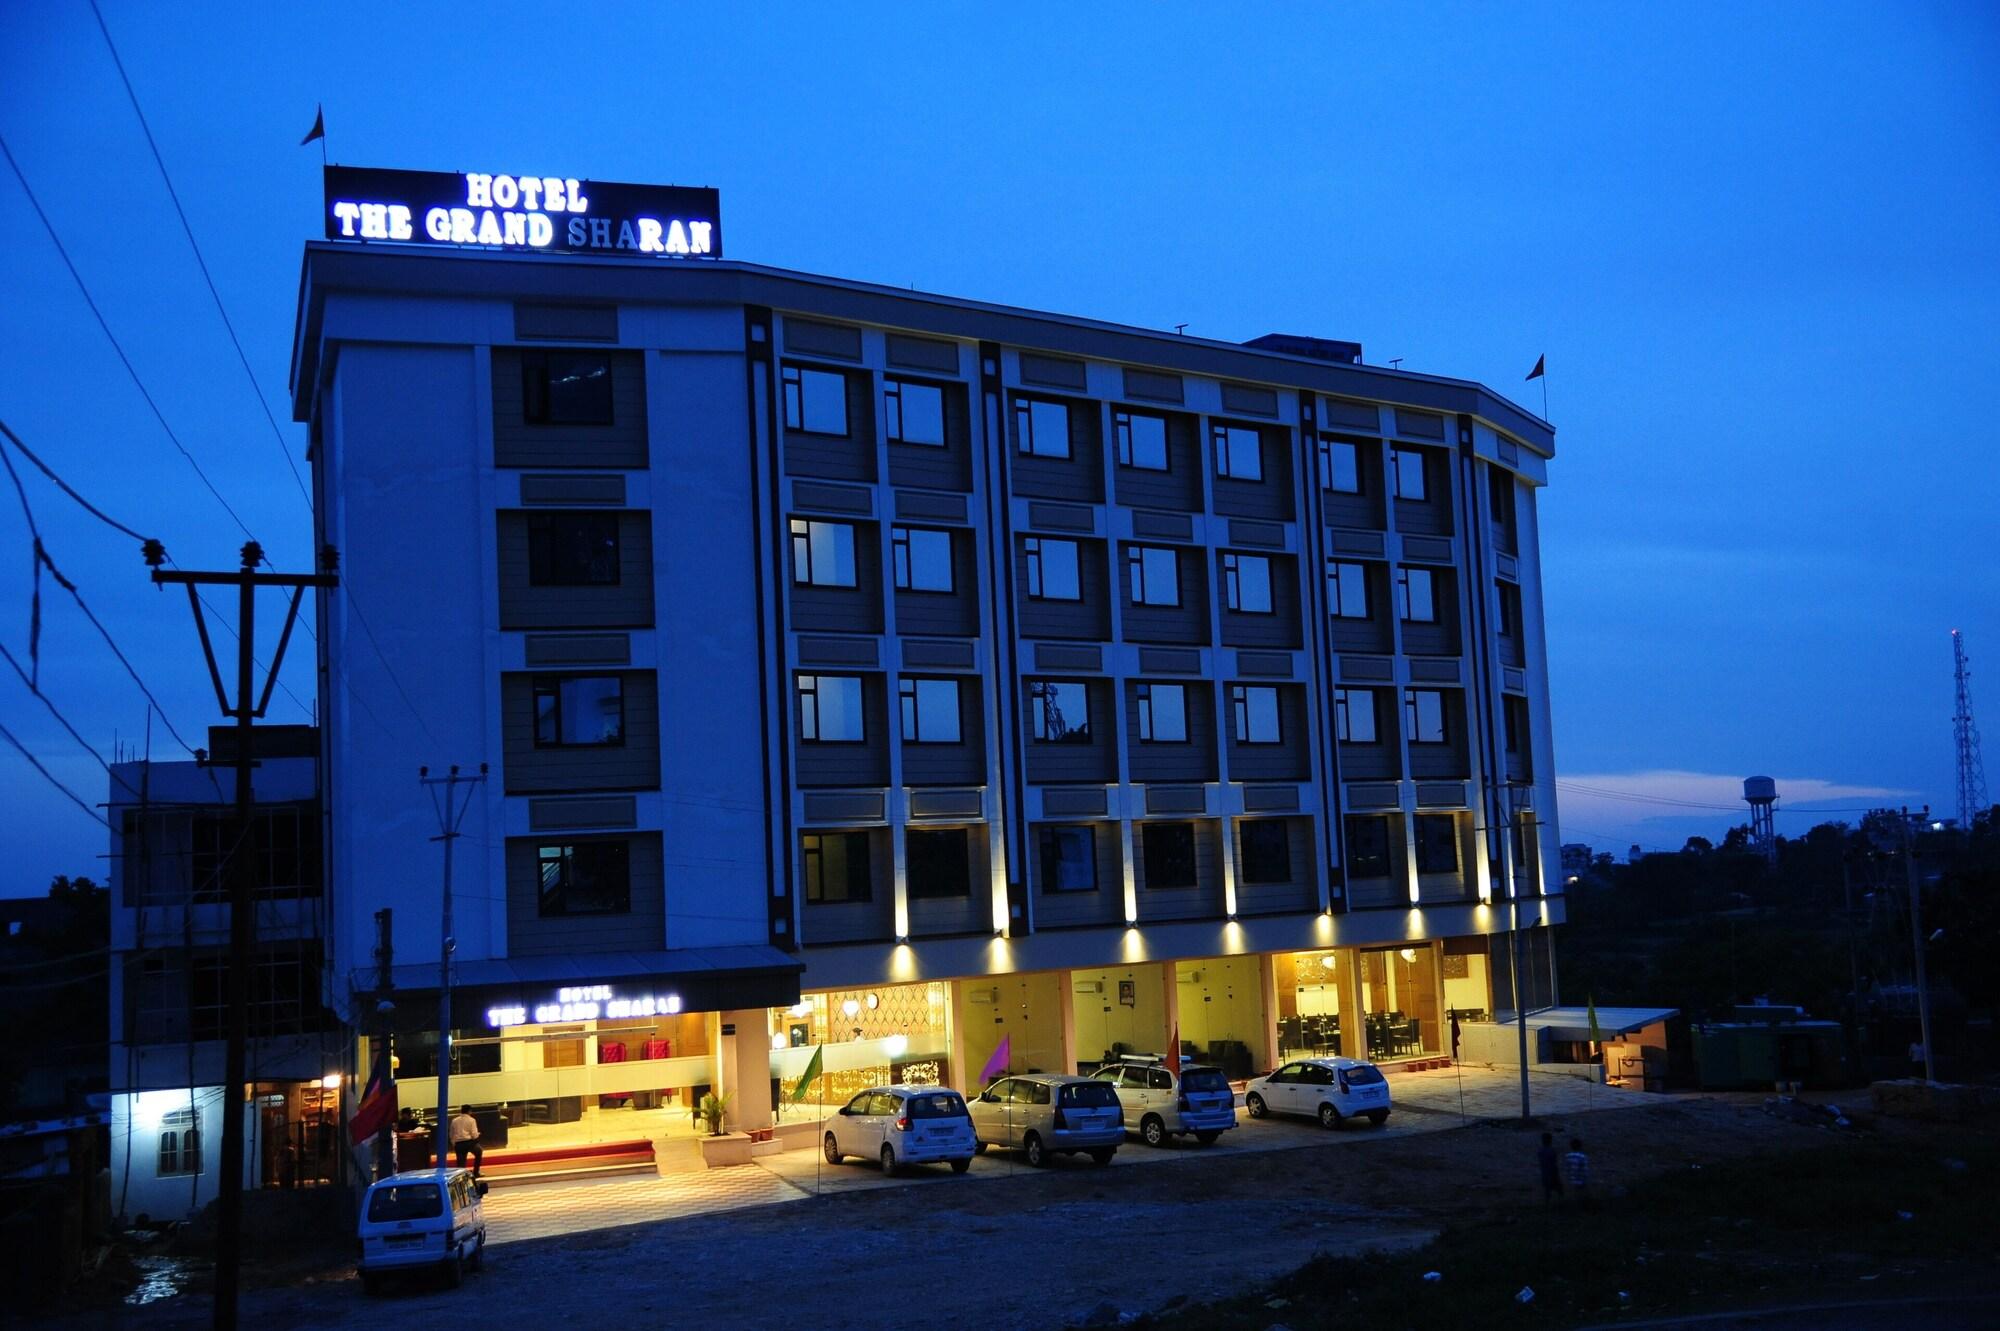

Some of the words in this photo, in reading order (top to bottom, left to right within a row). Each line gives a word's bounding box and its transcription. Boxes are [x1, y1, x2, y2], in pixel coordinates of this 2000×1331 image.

[466, 173, 588, 213] HOTEL
[334, 201, 412, 239] THE
[425, 207, 553, 247] GRAND
[567, 216, 712, 254] SHARAN
[488, 1007, 525, 1026] THE
